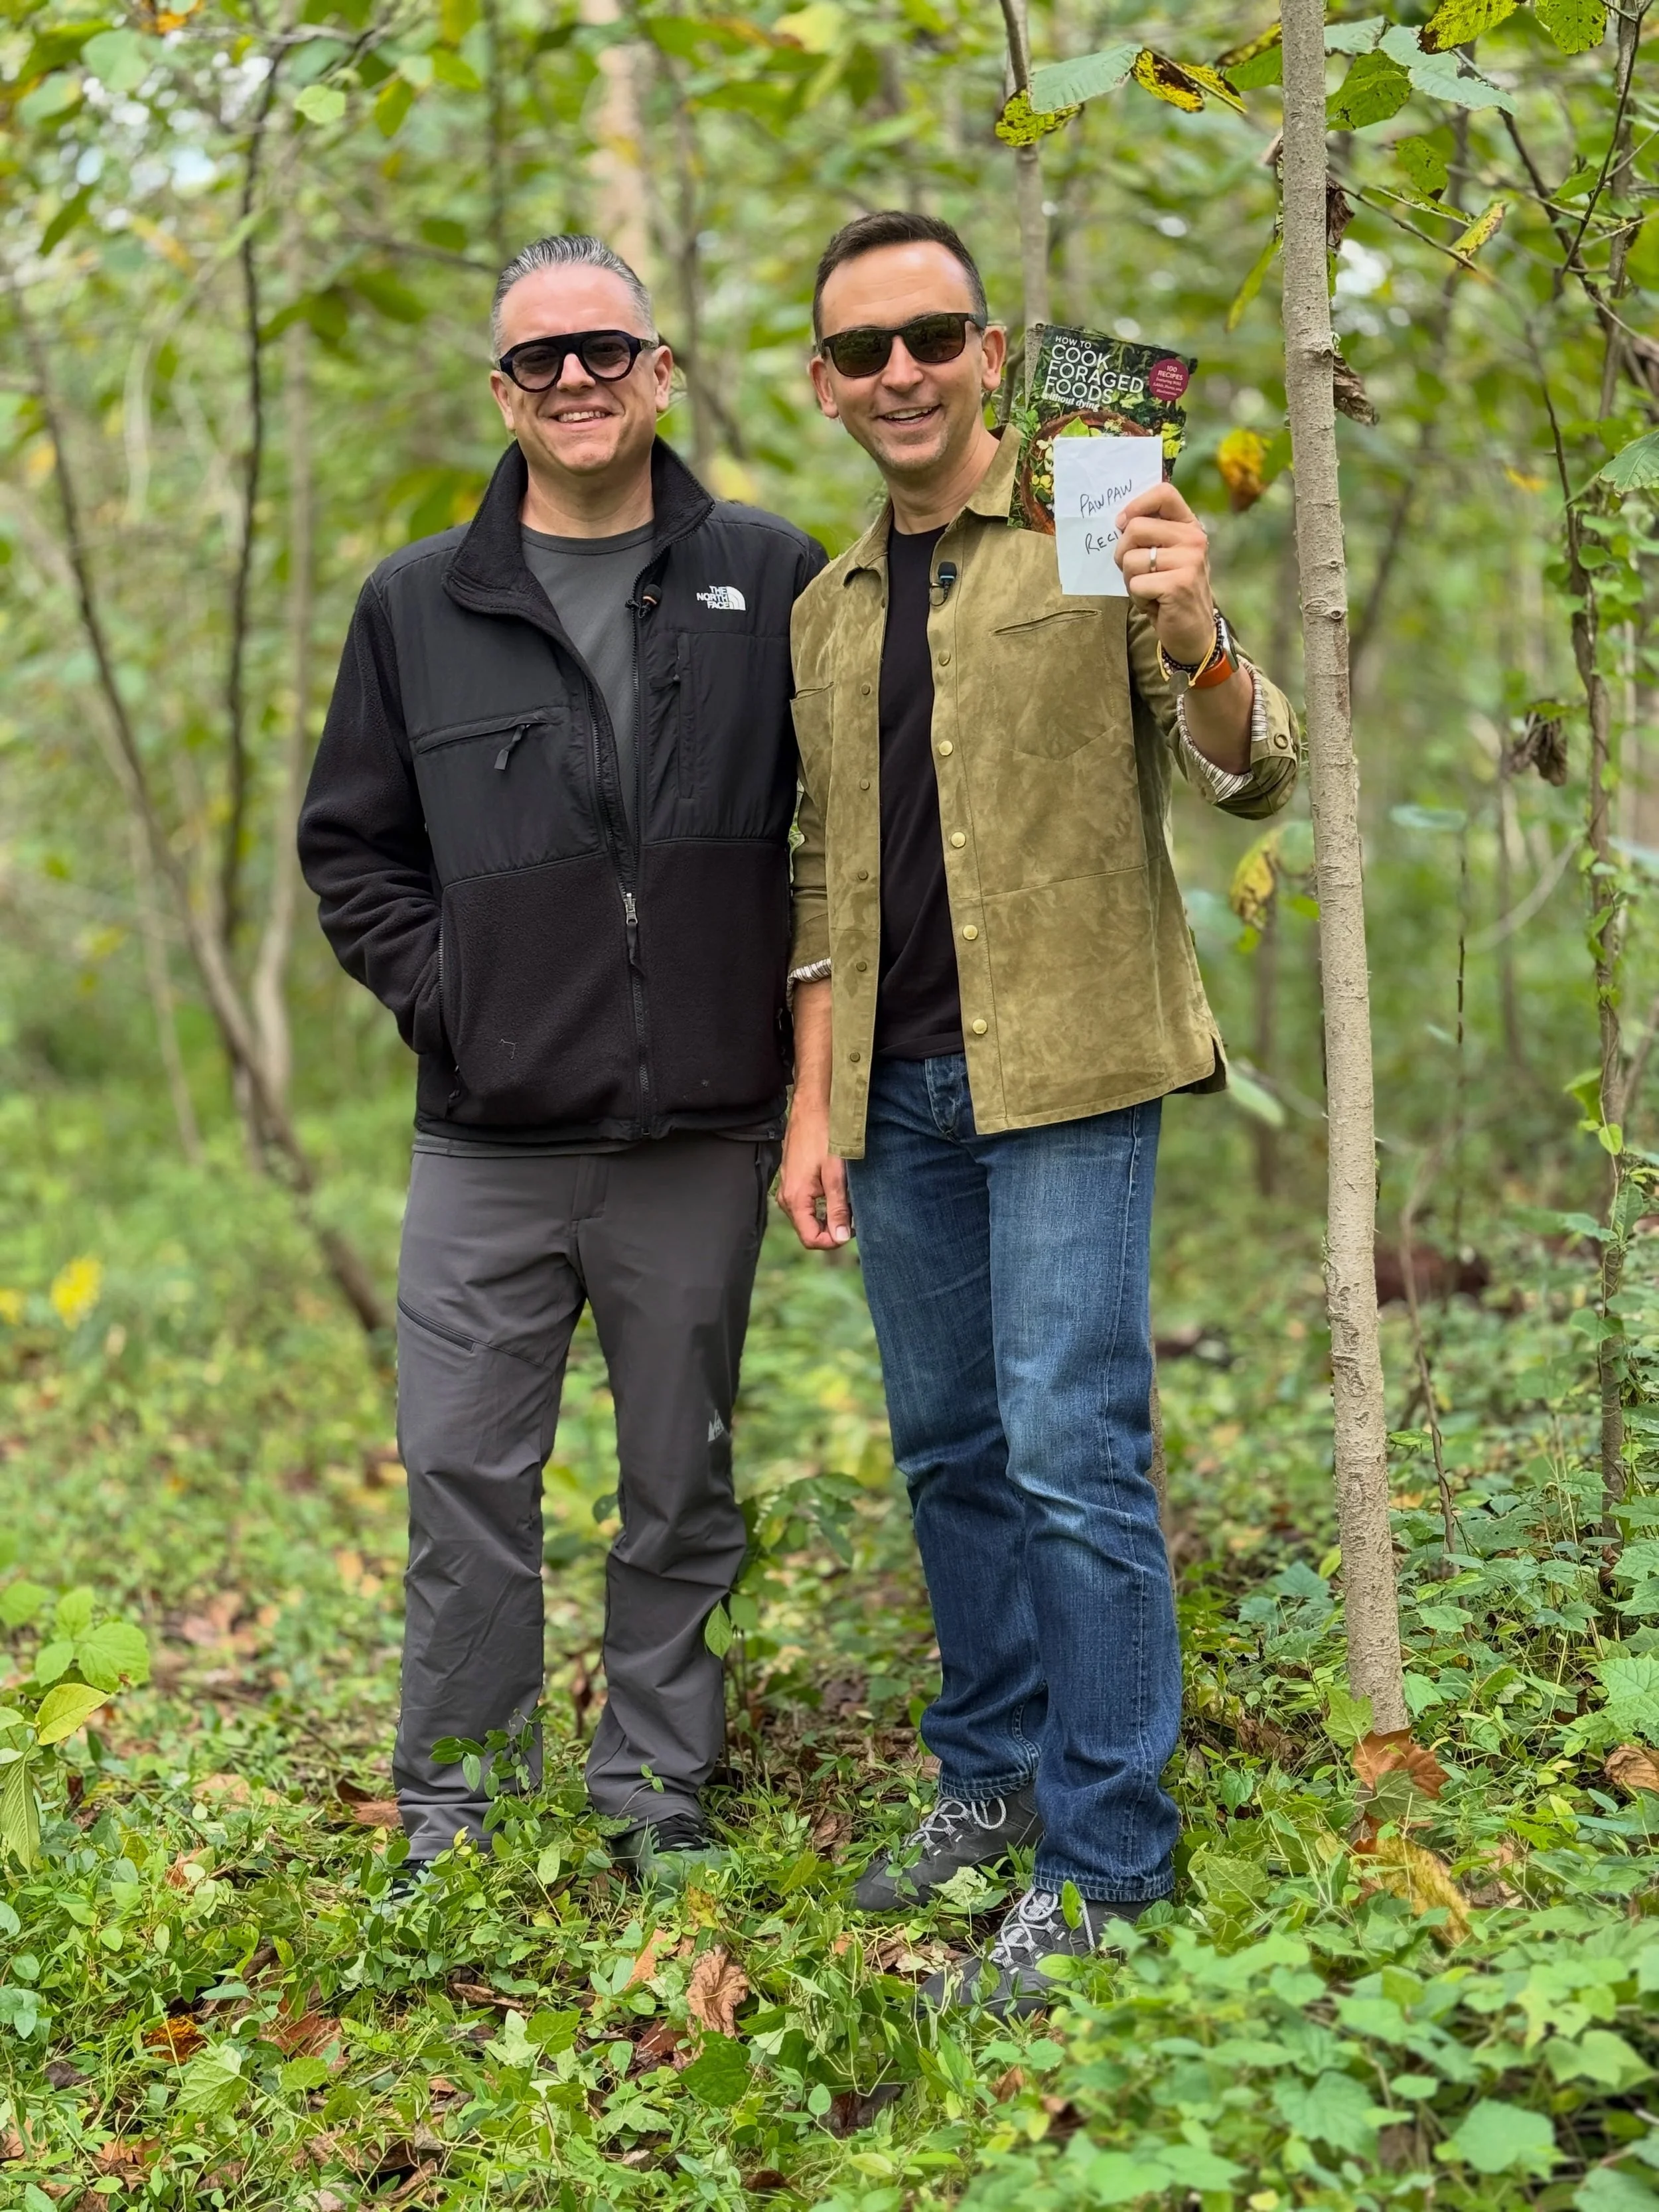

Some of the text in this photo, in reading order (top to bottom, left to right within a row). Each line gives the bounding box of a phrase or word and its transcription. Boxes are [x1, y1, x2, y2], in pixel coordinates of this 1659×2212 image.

[1055, 335, 1092, 349] HOW TO
[1052, 344, 1111, 370] COOK
[1048, 359, 1144, 394] FORAGED
[1157, 370, 1183, 380] RECIPES
[1043, 376, 1114, 404] FOODS
[1043, 392, 1100, 412] without dying
[1085, 531, 1119, 554] RECI
[696, 593, 728, 602] NORTH
[709, 585, 727, 595] THE
[707, 601, 730, 609] FACE
